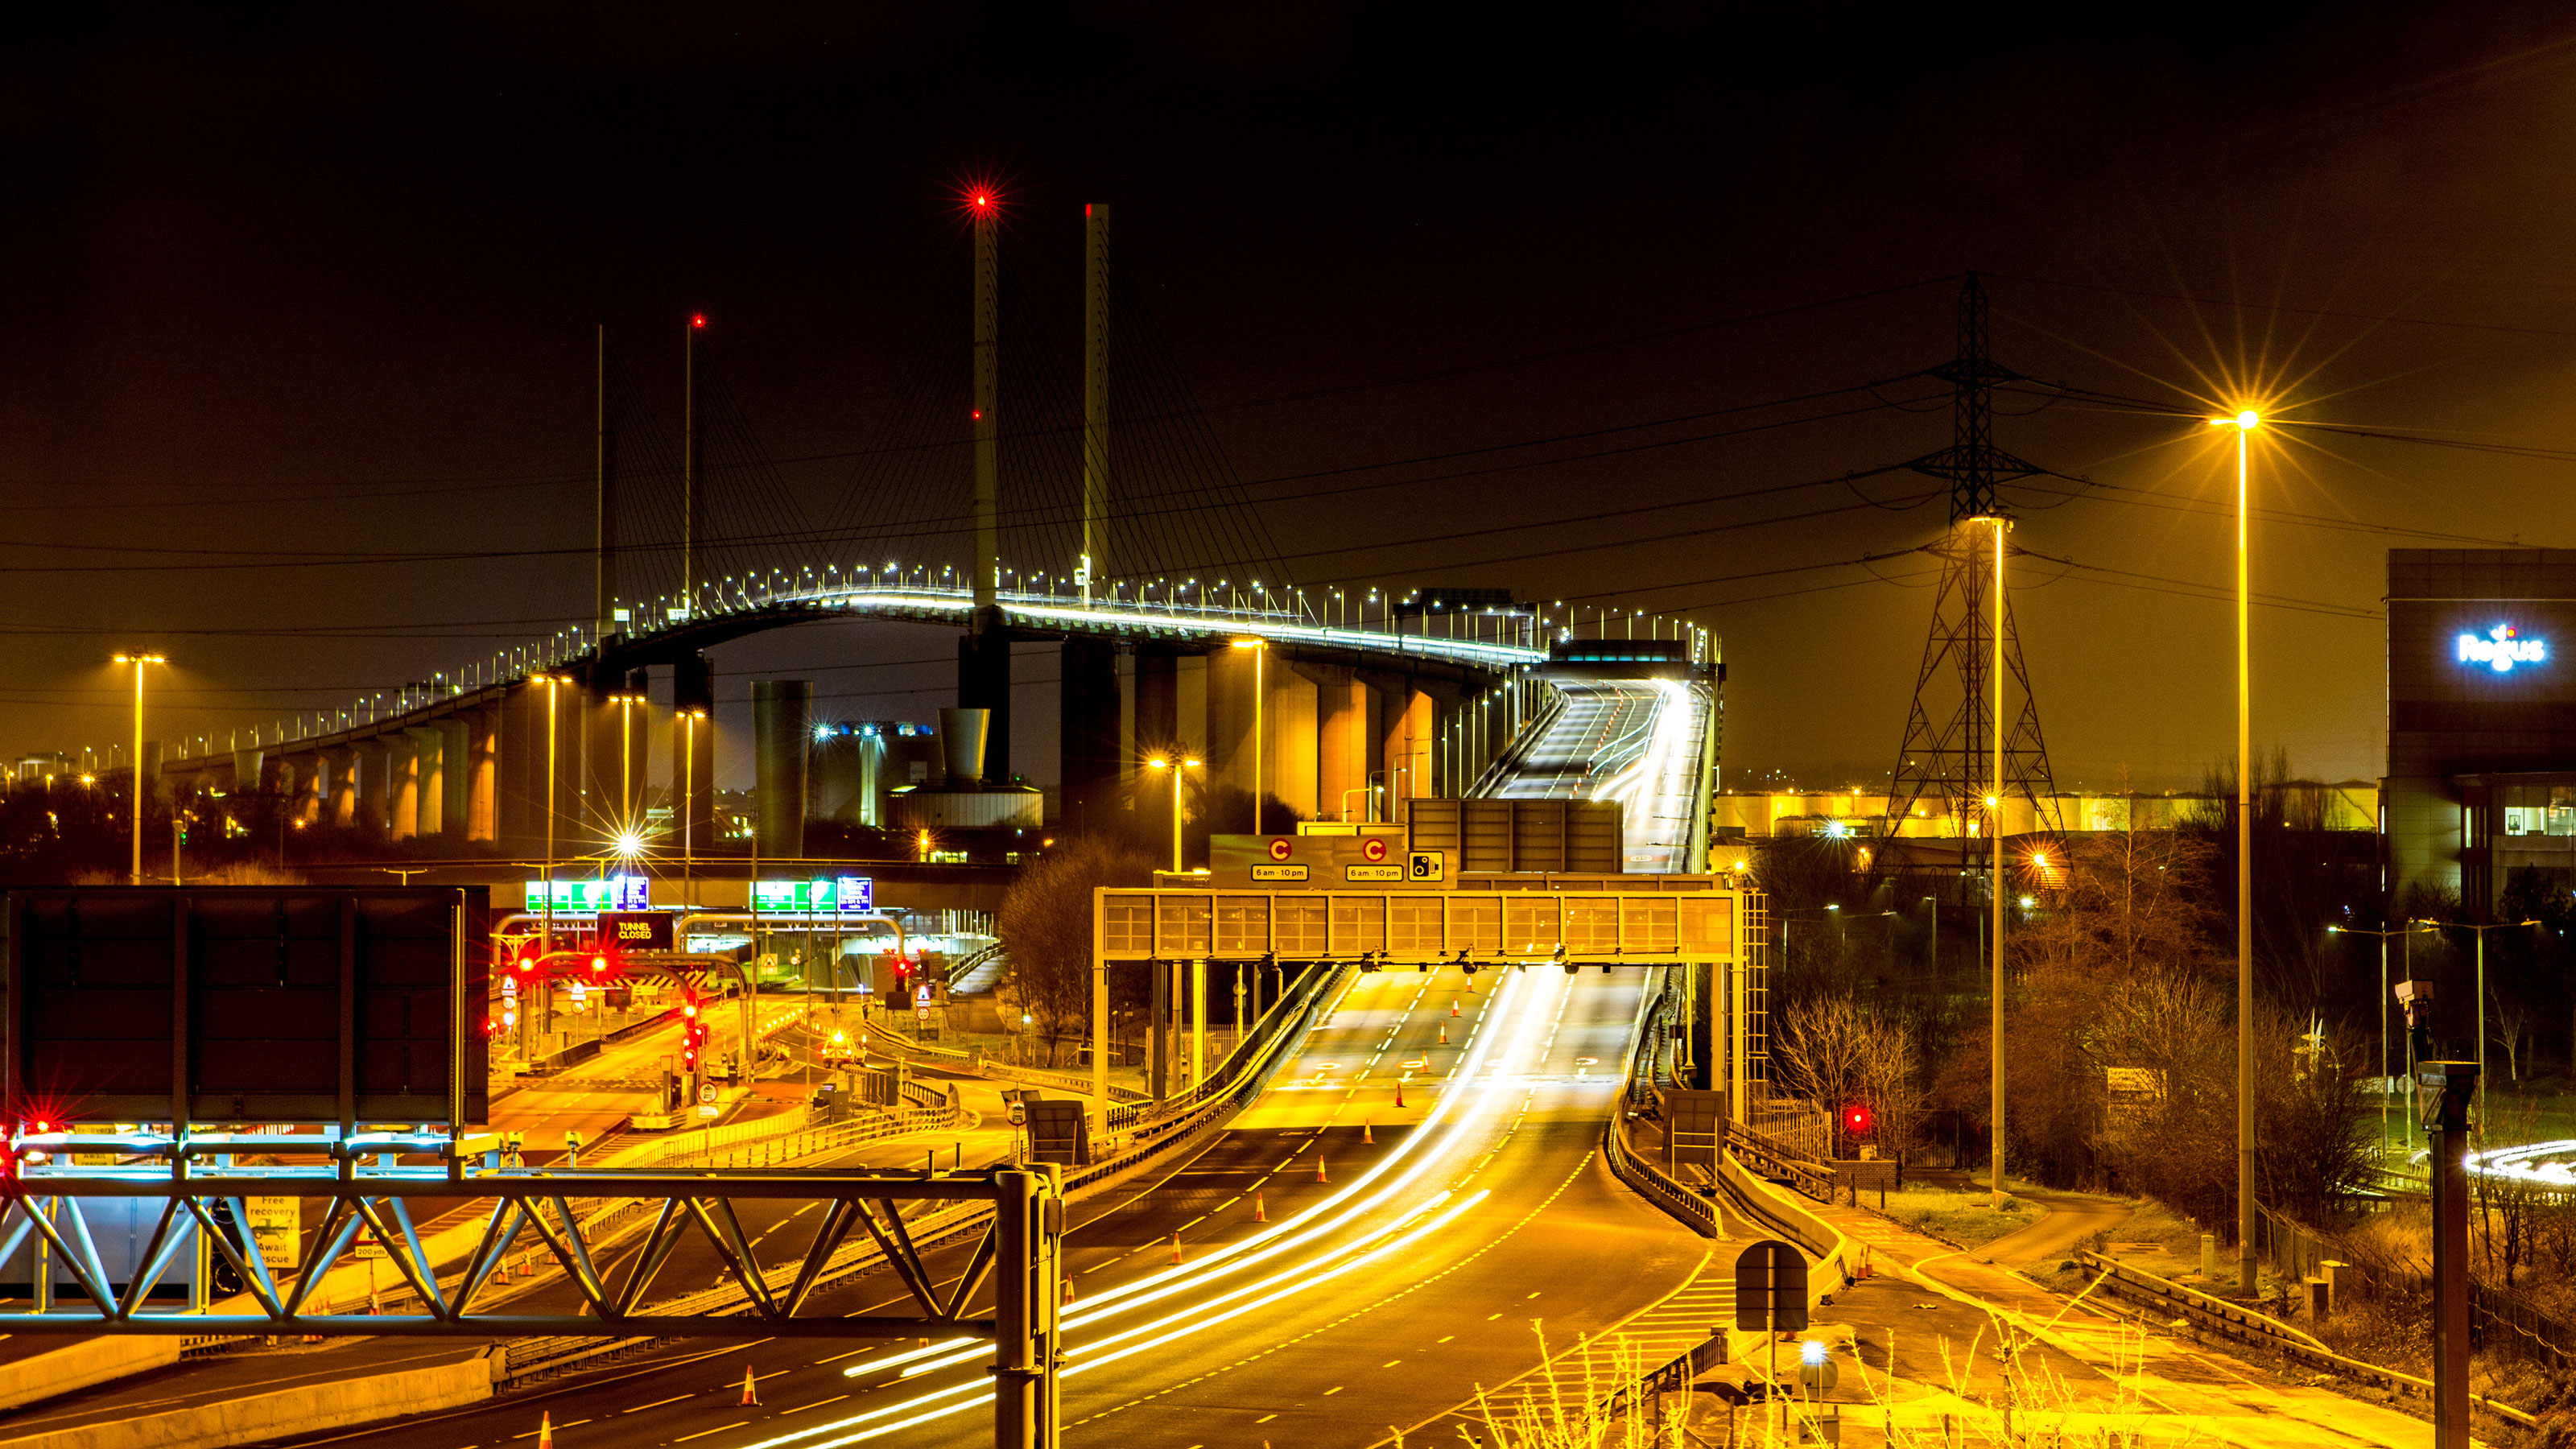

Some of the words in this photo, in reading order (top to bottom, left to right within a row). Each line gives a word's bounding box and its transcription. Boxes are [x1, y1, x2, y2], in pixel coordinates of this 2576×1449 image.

[2459, 634, 2545, 671] Regus
[618, 923, 651, 931] TUNNEL
[618, 931, 651, 939] CLOSED
[250, 1208, 295, 1217] recovery
[374, 1248, 386, 1257] yds
